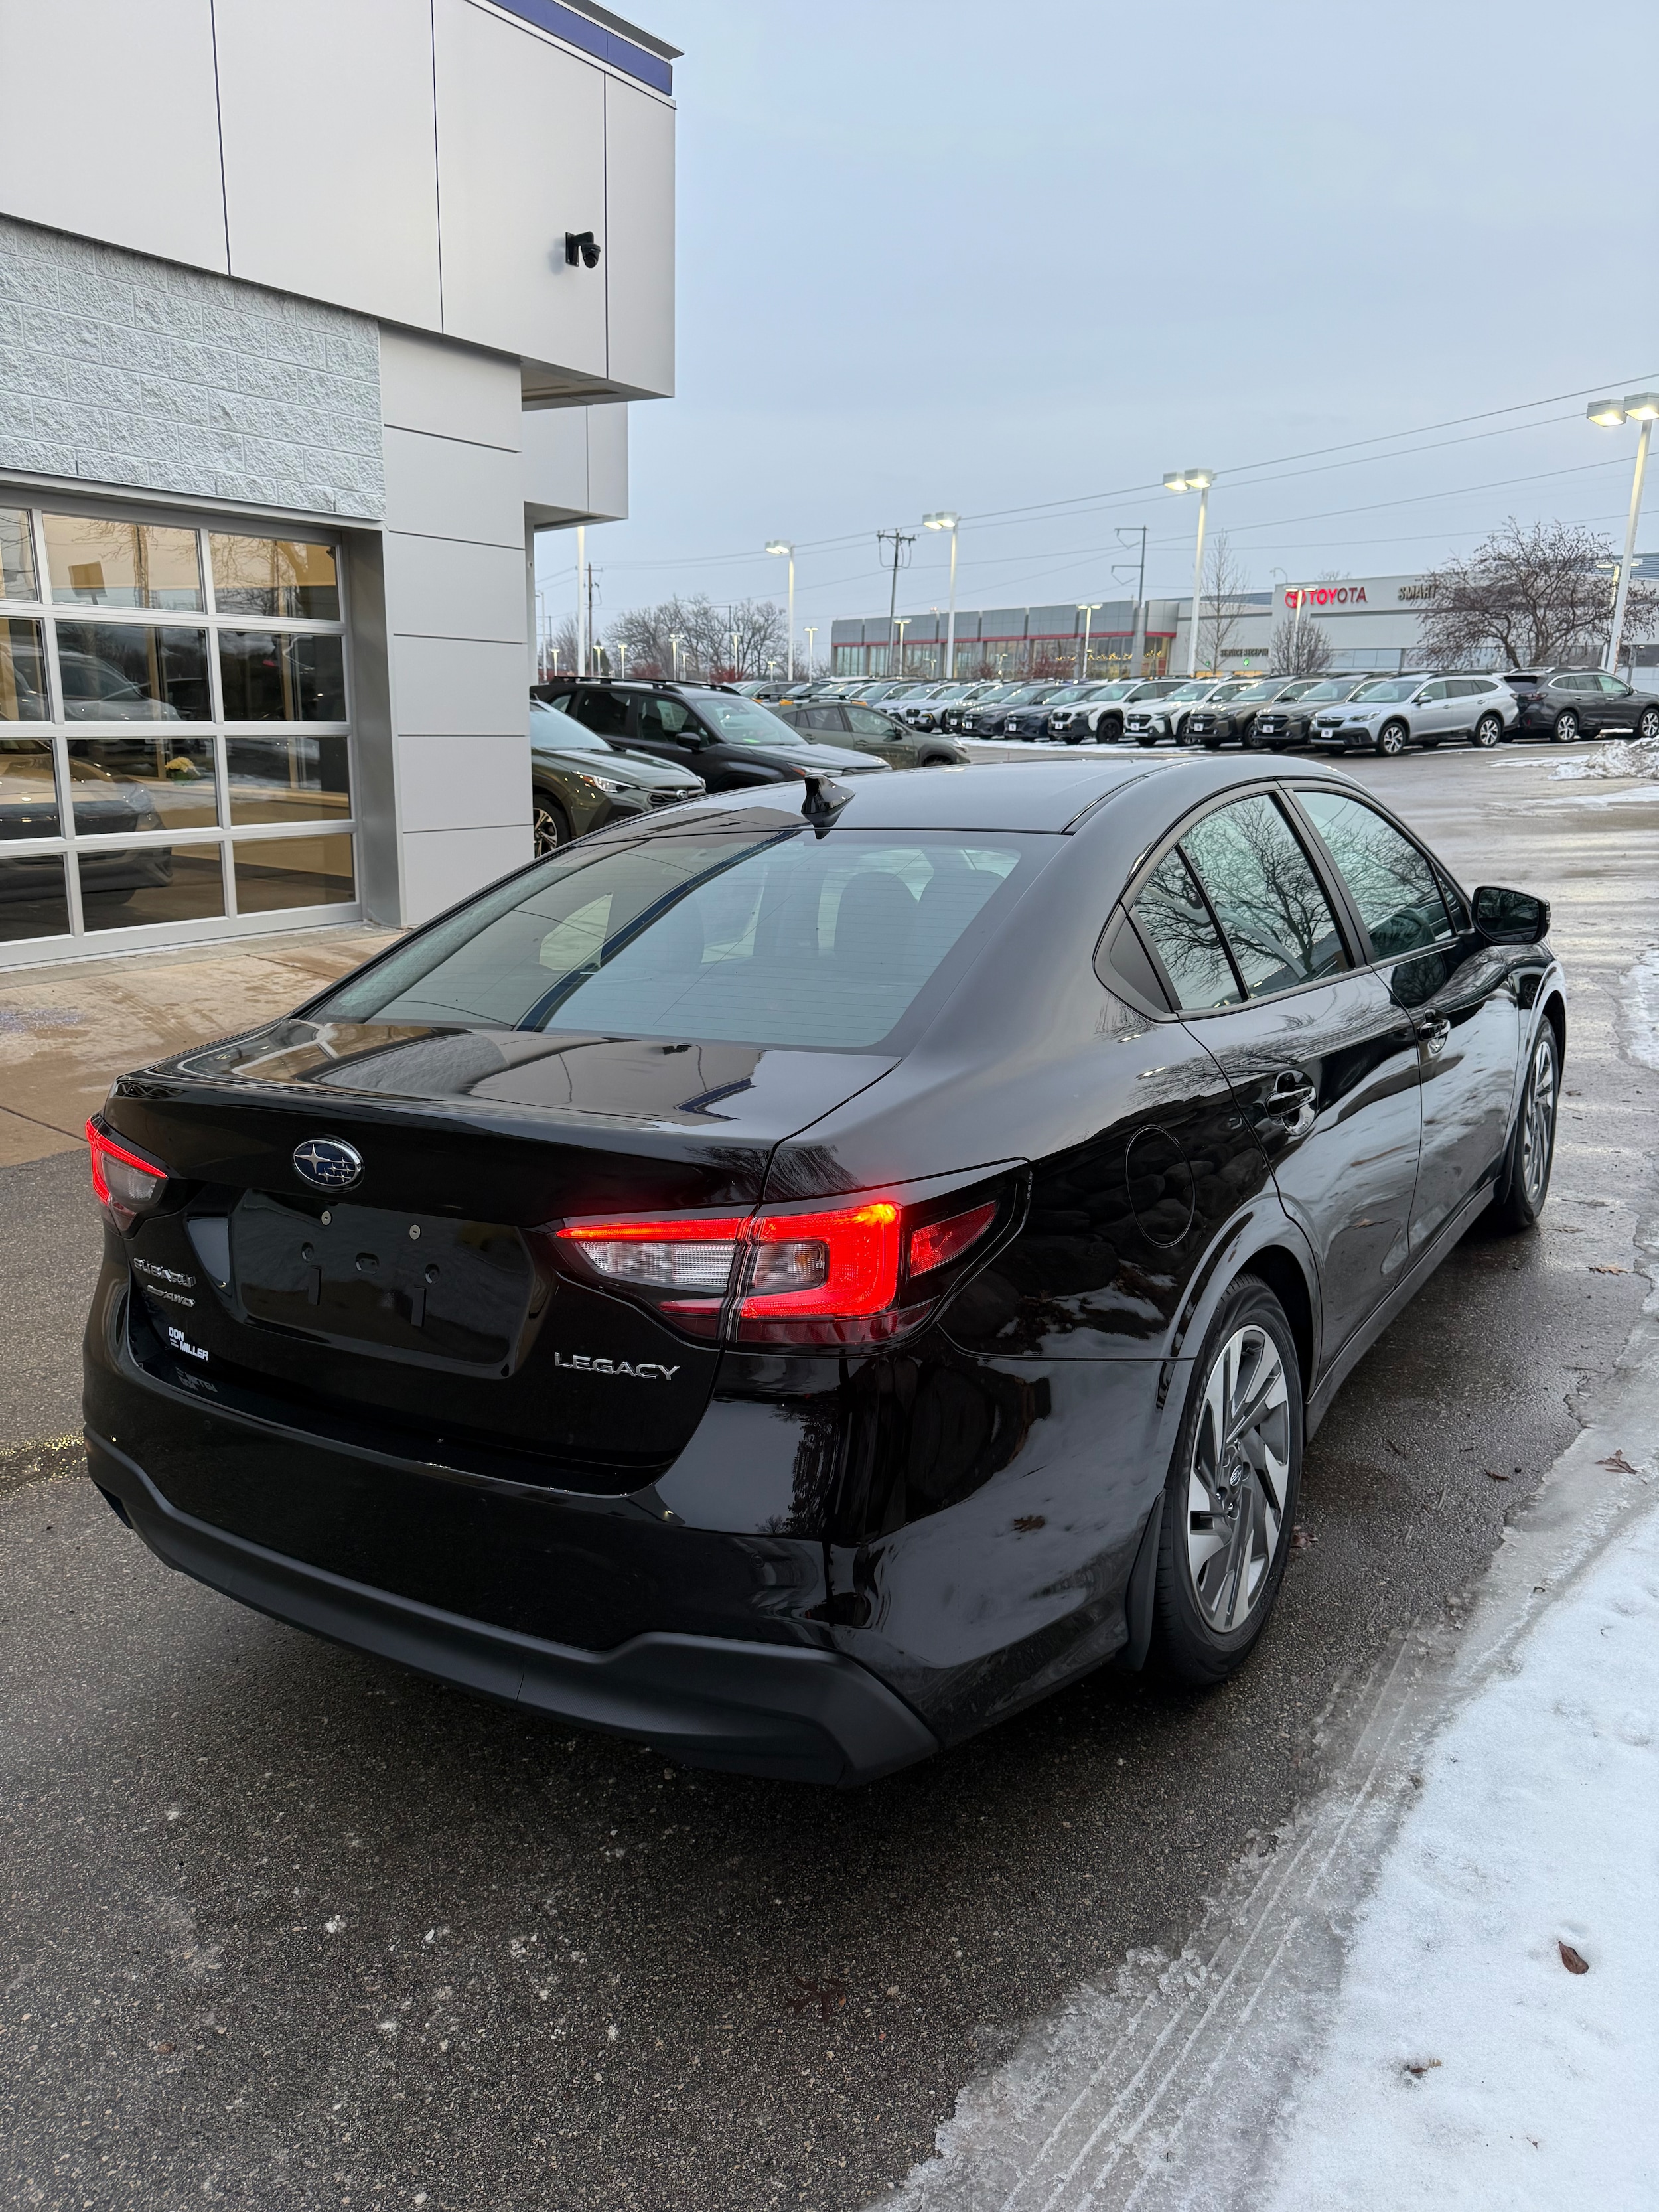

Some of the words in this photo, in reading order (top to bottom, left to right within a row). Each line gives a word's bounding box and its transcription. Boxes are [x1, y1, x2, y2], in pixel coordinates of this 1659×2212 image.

[1308, 587, 1367, 605] TOYOTA
[133, 1258, 196, 1288] SUBARU
[163, 1292, 195, 1307] AWD
[169, 1326, 184, 1341] DON
[180, 1341, 209, 1361] MILLER
[554, 1351, 680, 1381] LEGACY
